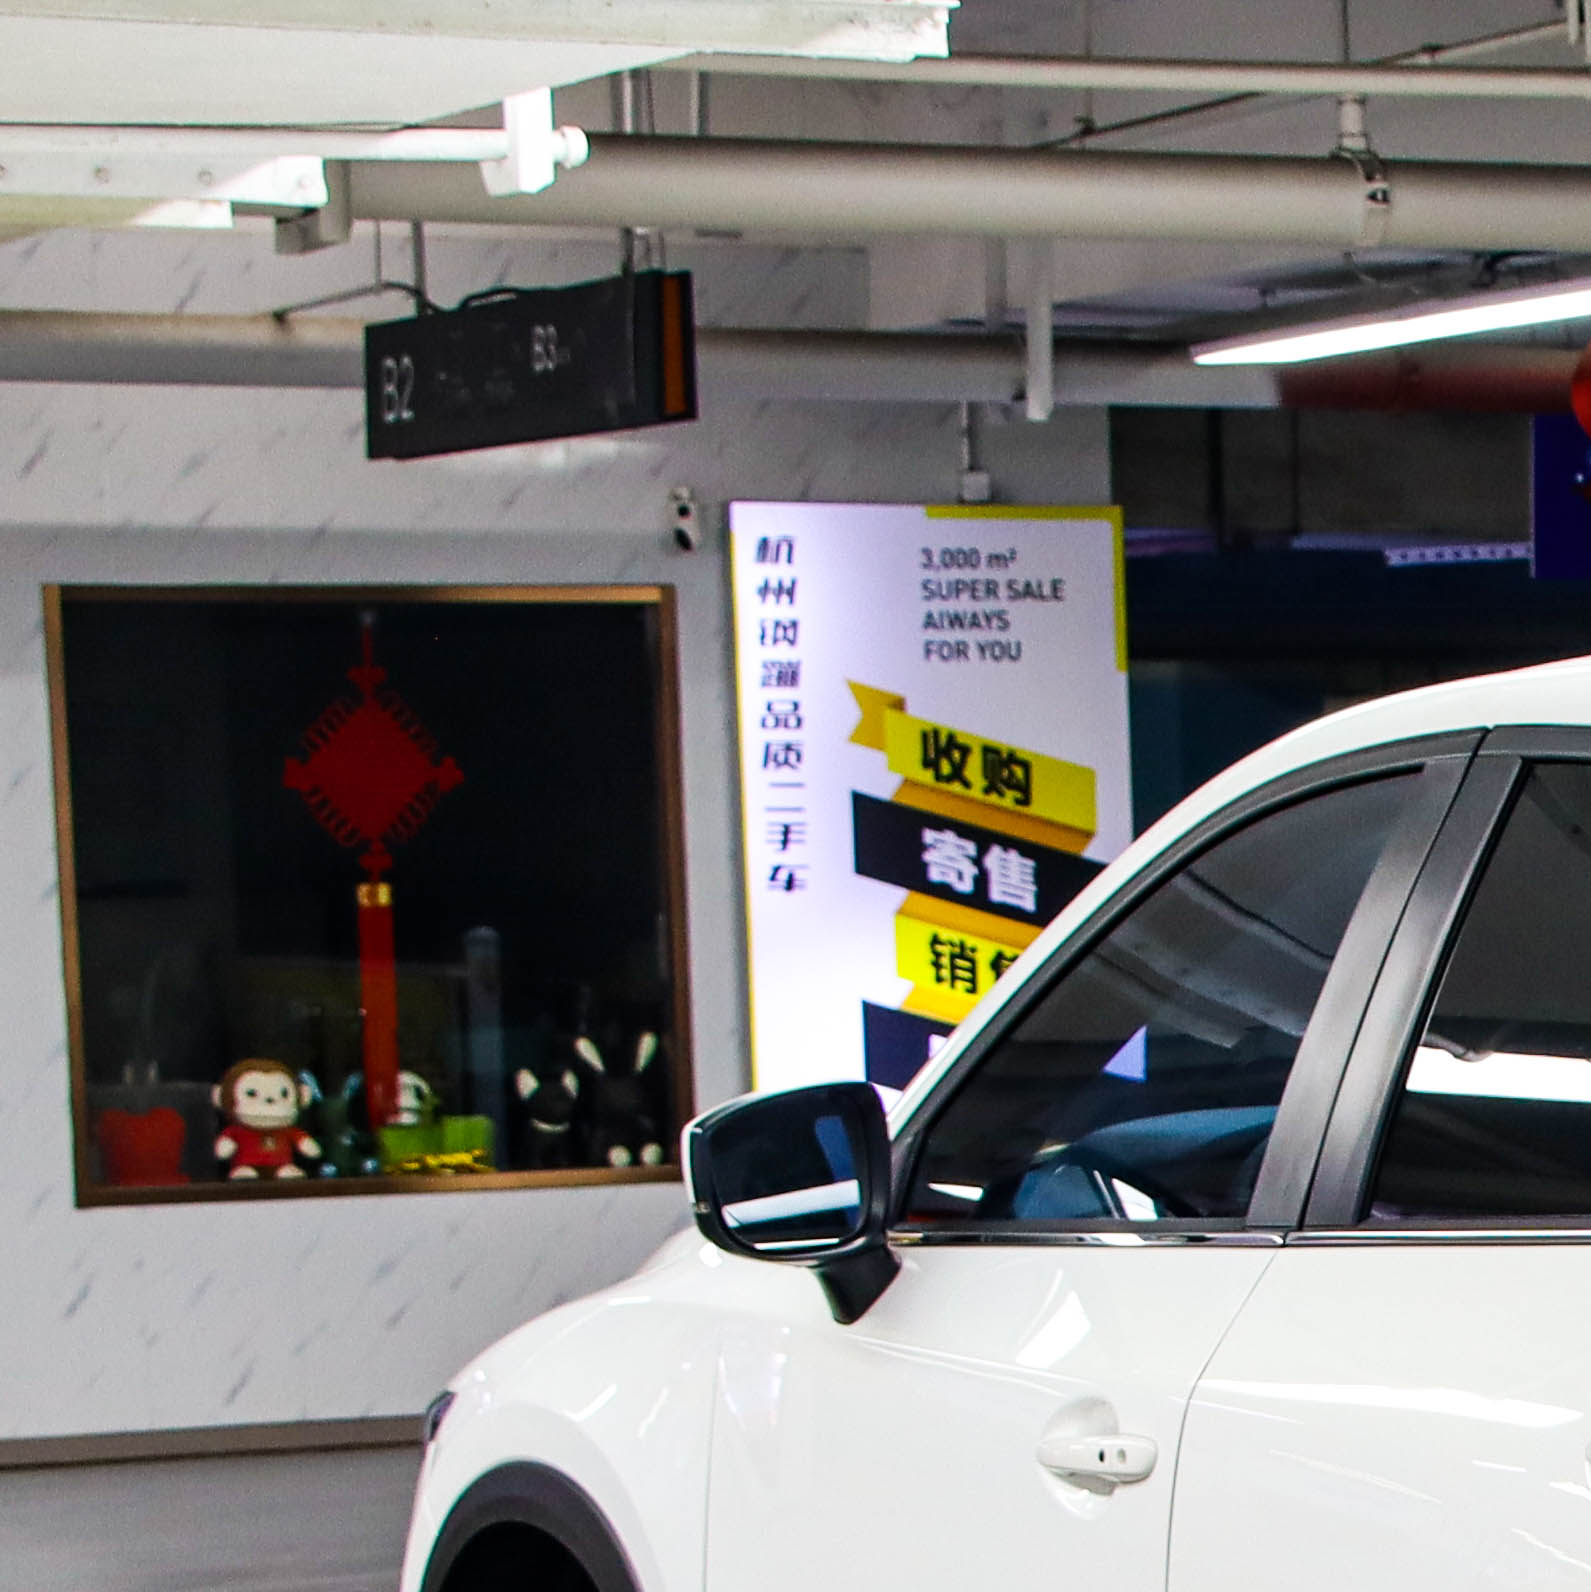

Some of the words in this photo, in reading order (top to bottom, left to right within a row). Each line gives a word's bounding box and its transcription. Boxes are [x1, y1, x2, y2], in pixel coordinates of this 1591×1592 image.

[379, 355, 416, 424] B2
[921, 578, 1000, 601] SUPER
[1006, 578, 1066, 602] SALE
[924, 638, 970, 661] FOR
[976, 638, 1022, 662] YOU
[920, 727, 1034, 808] 收购
[920, 828, 1038, 914] 寄售
